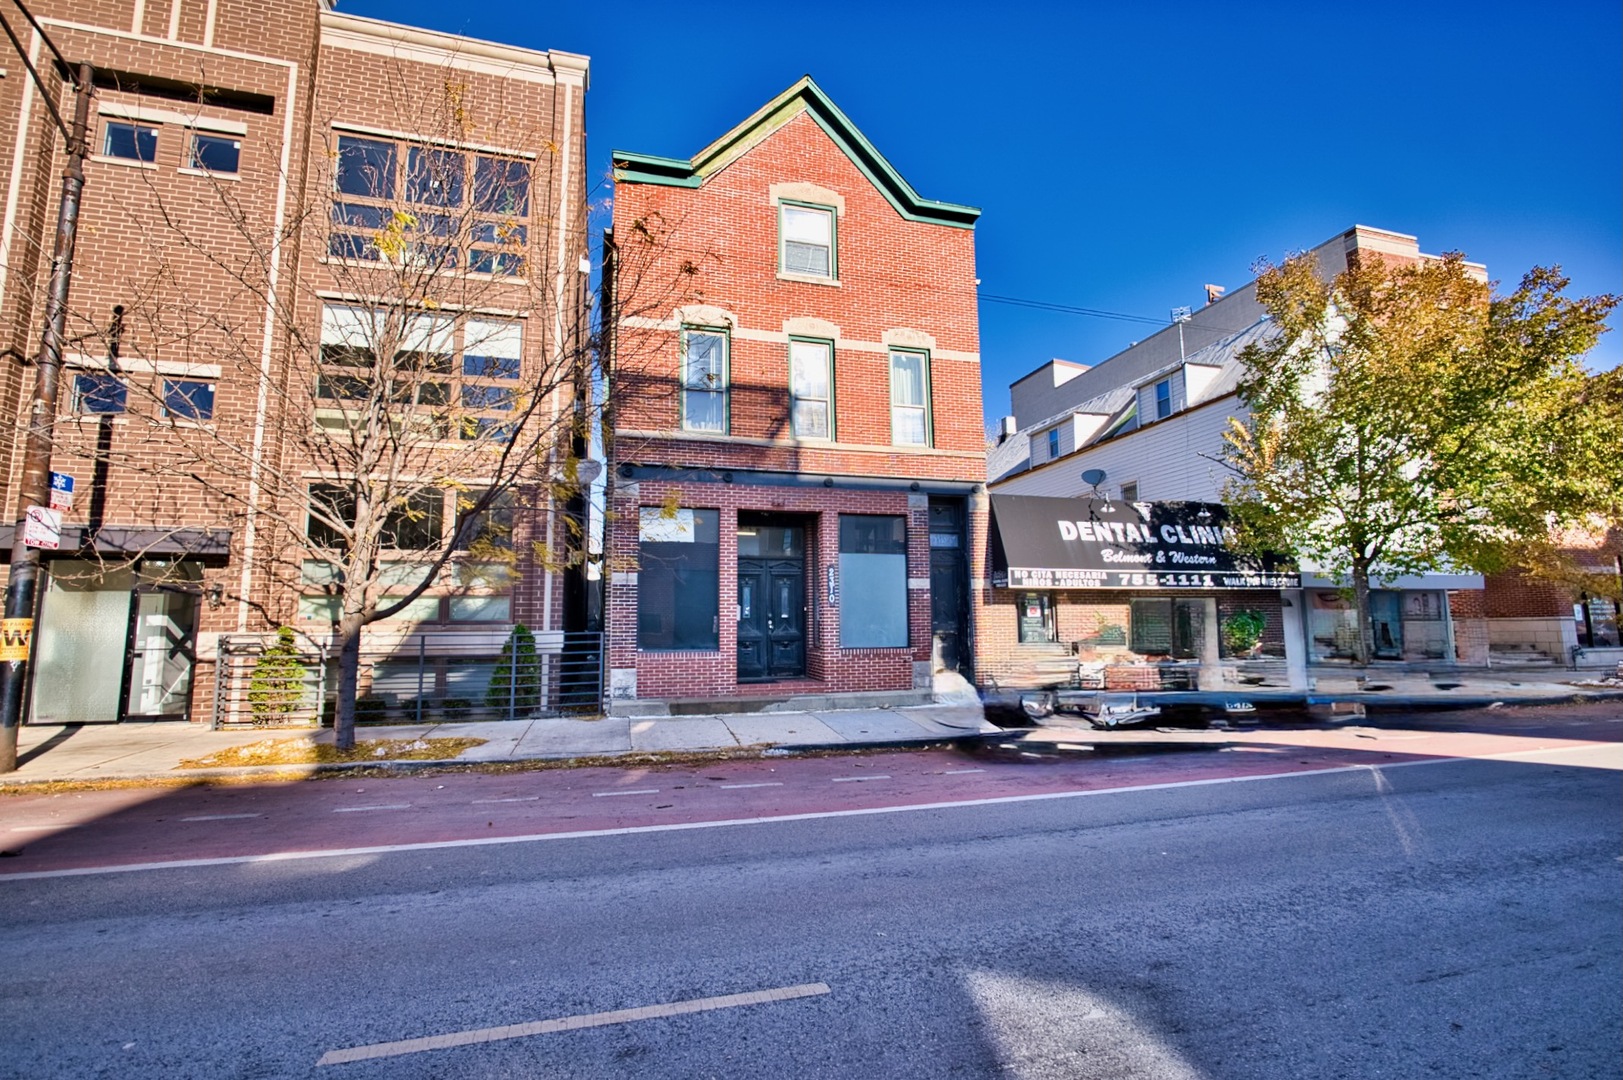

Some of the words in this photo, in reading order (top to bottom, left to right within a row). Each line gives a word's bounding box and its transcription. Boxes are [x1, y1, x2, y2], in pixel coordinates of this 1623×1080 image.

[1057, 520, 1158, 544] DENTAL
[1100, 548, 1153, 564] Belmont
[1155, 550, 1166, 564] &
[1168, 550, 1217, 565] Western
[1014, 570, 1028, 578] NO
[1031, 570, 1053, 579] CITA
[1055, 571, 1108, 580] NECESARIA
[1118, 573, 1215, 587] 755-1111
[1222, 576, 1246, 587] WALK
